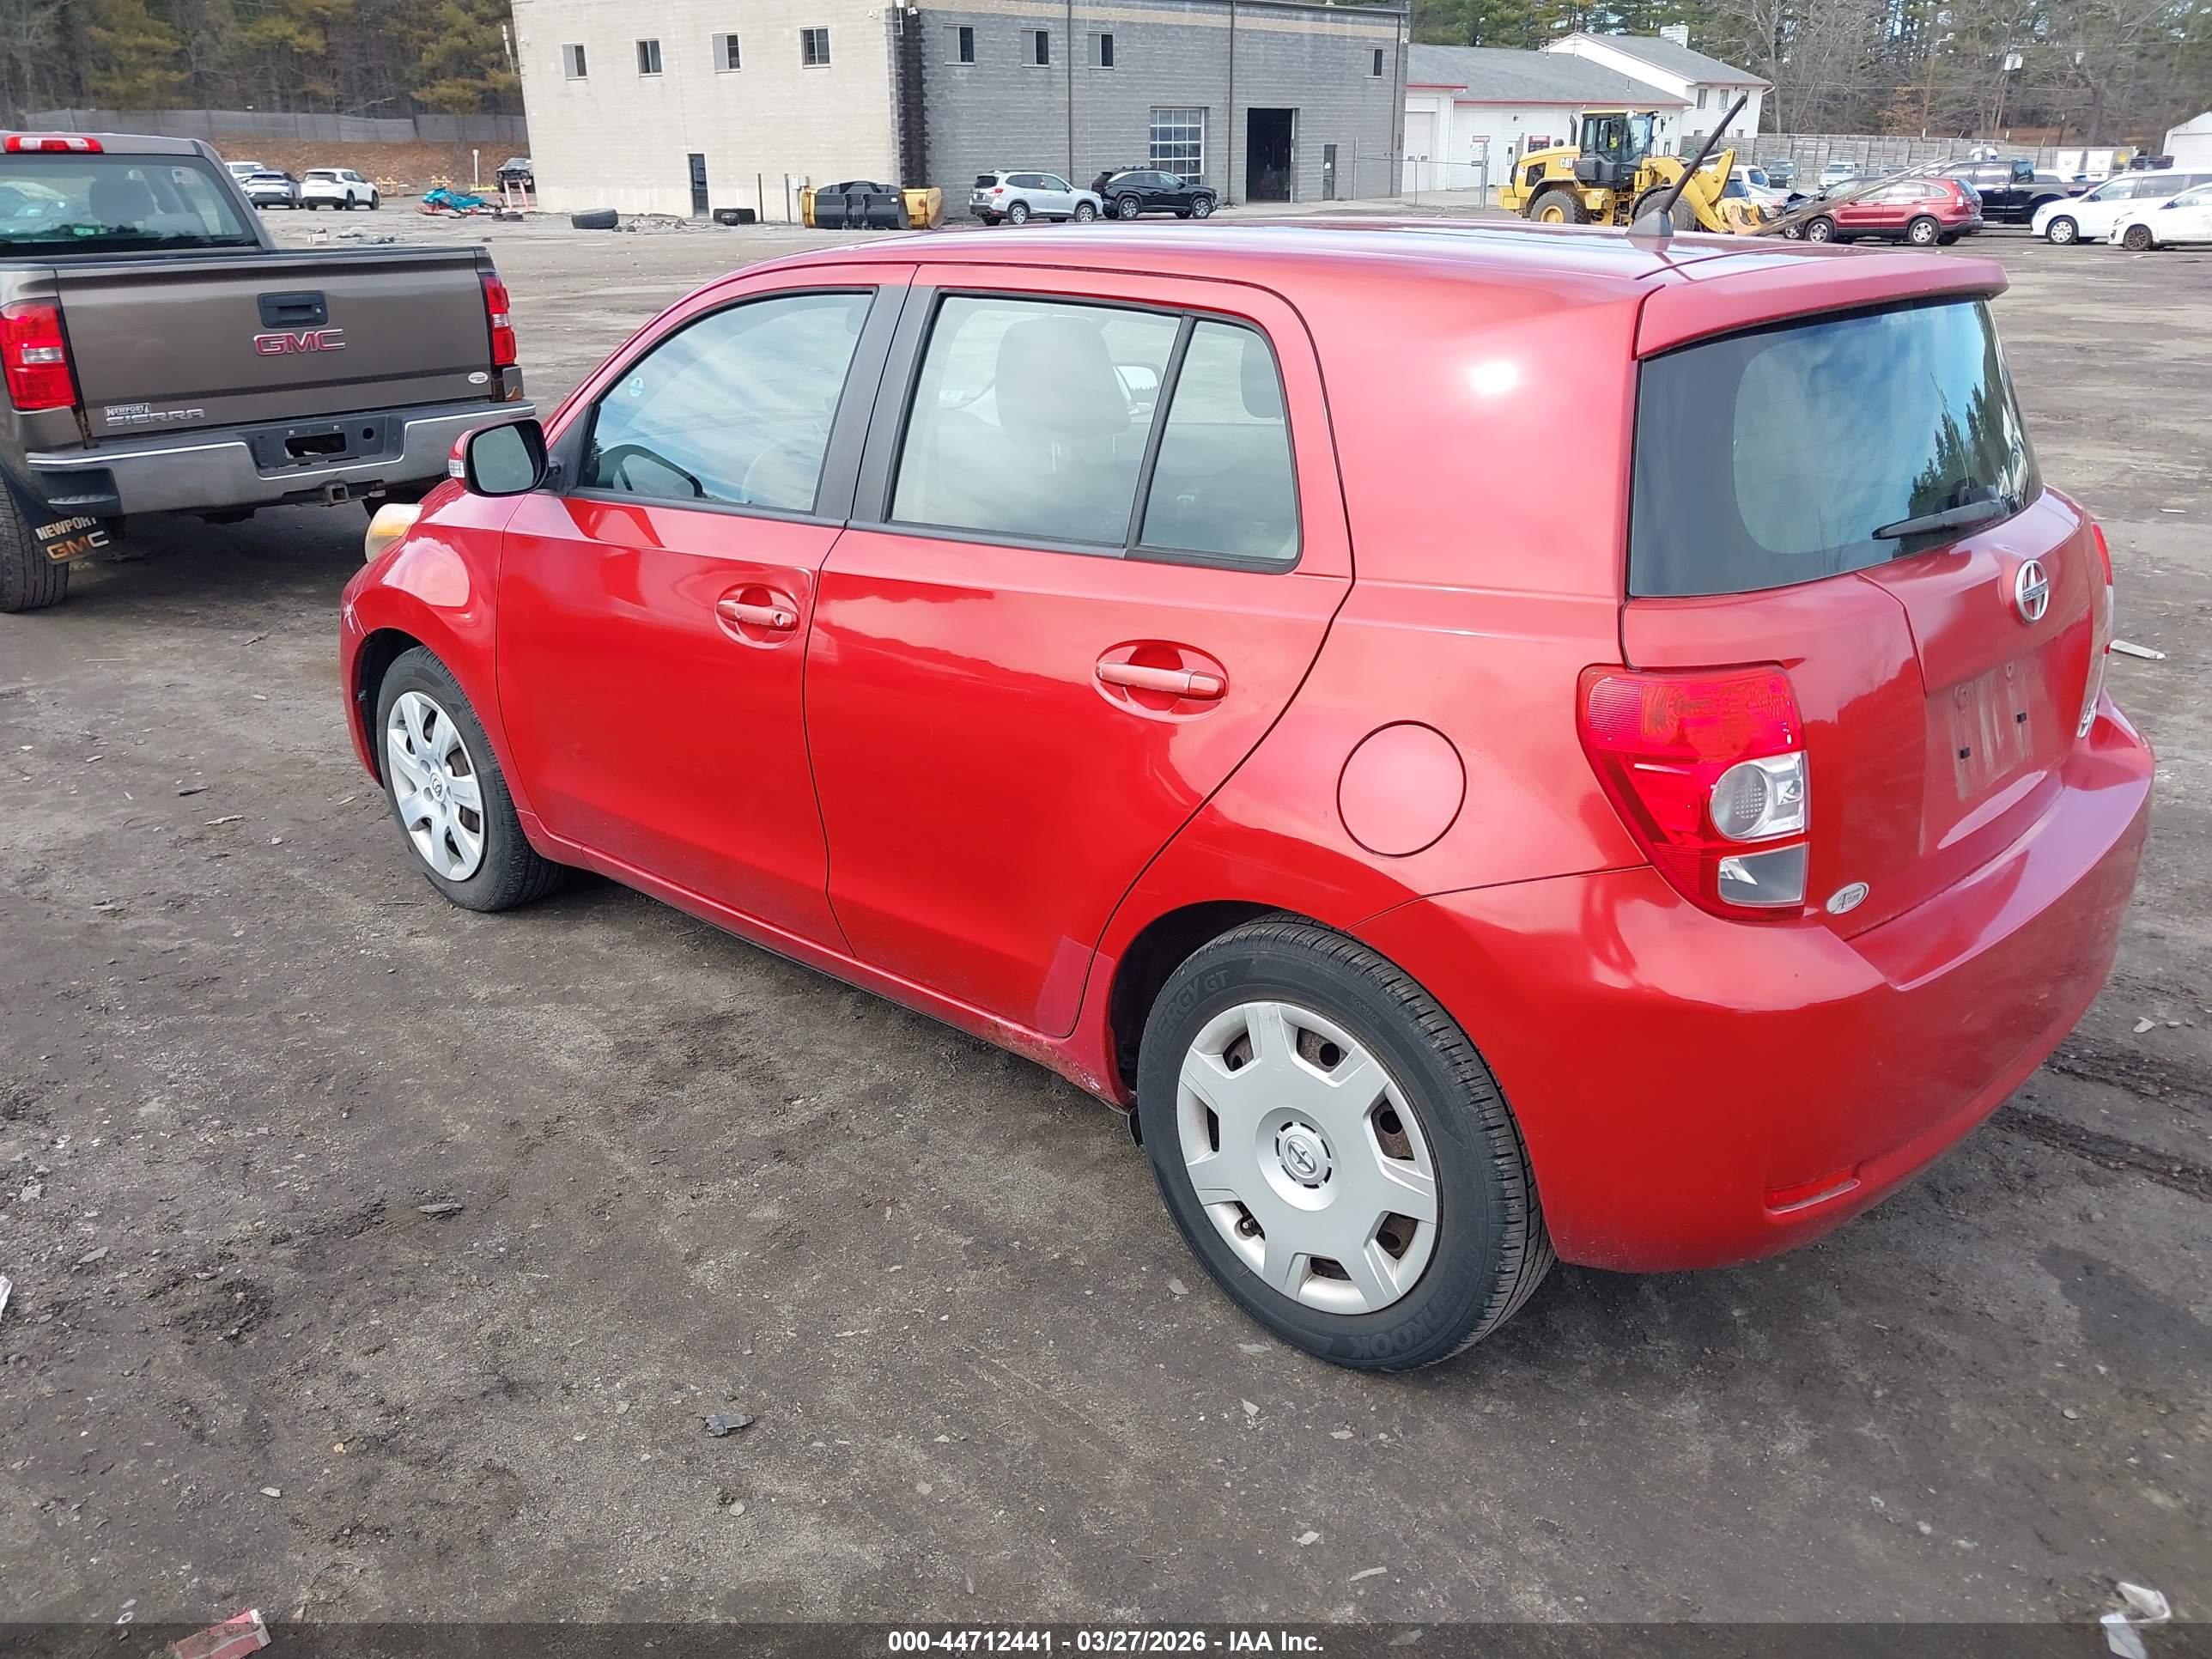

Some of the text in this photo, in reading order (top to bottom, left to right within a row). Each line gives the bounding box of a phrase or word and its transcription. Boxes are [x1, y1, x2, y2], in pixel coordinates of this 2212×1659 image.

[1559, 157, 1574, 168] CAT
[253, 328, 345, 355] GMC
[106, 404, 145, 416] NEWPORT
[106, 408, 205, 426] SIERRA
[35, 516, 97, 541] NEWPORT
[46, 530, 111, 560] GMC
[1203, 969, 1229, 991] GT
